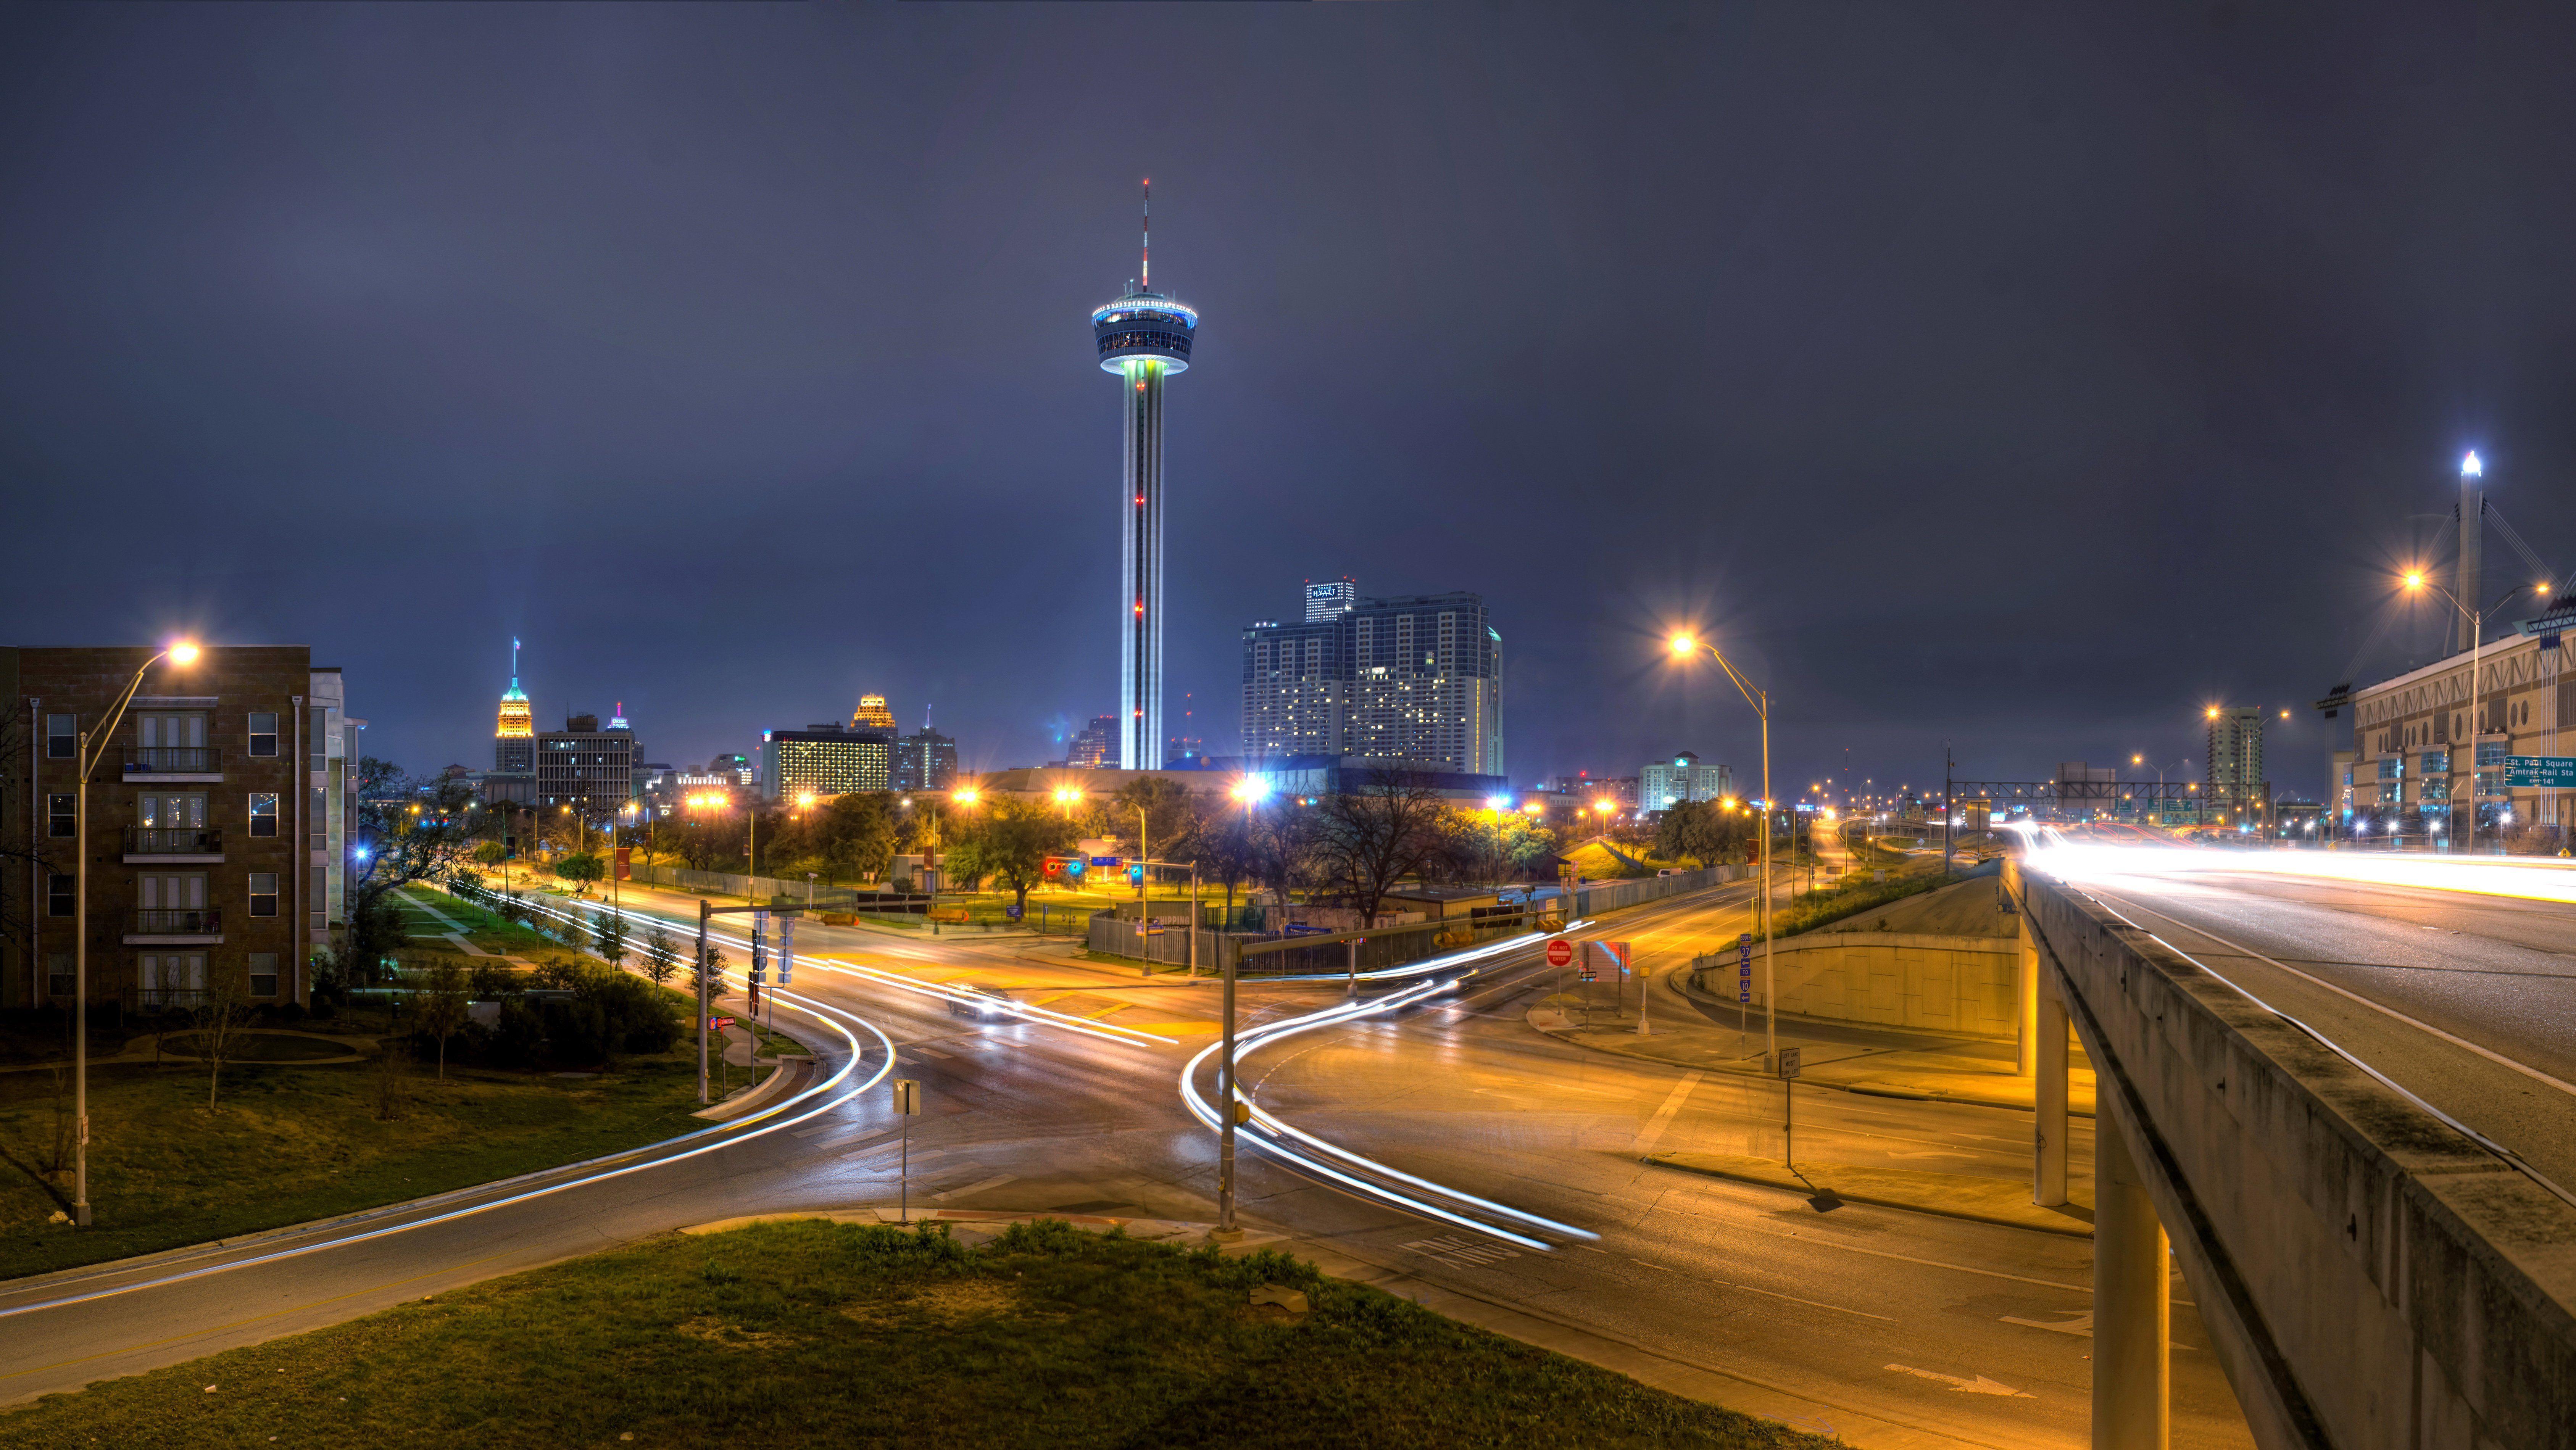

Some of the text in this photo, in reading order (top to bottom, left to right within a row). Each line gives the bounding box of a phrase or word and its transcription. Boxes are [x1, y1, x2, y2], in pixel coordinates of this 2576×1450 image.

[1313, 589, 1336, 597] HYATT
[2545, 760, 2573, 768] Square
[1742, 983, 1748, 991] 10
